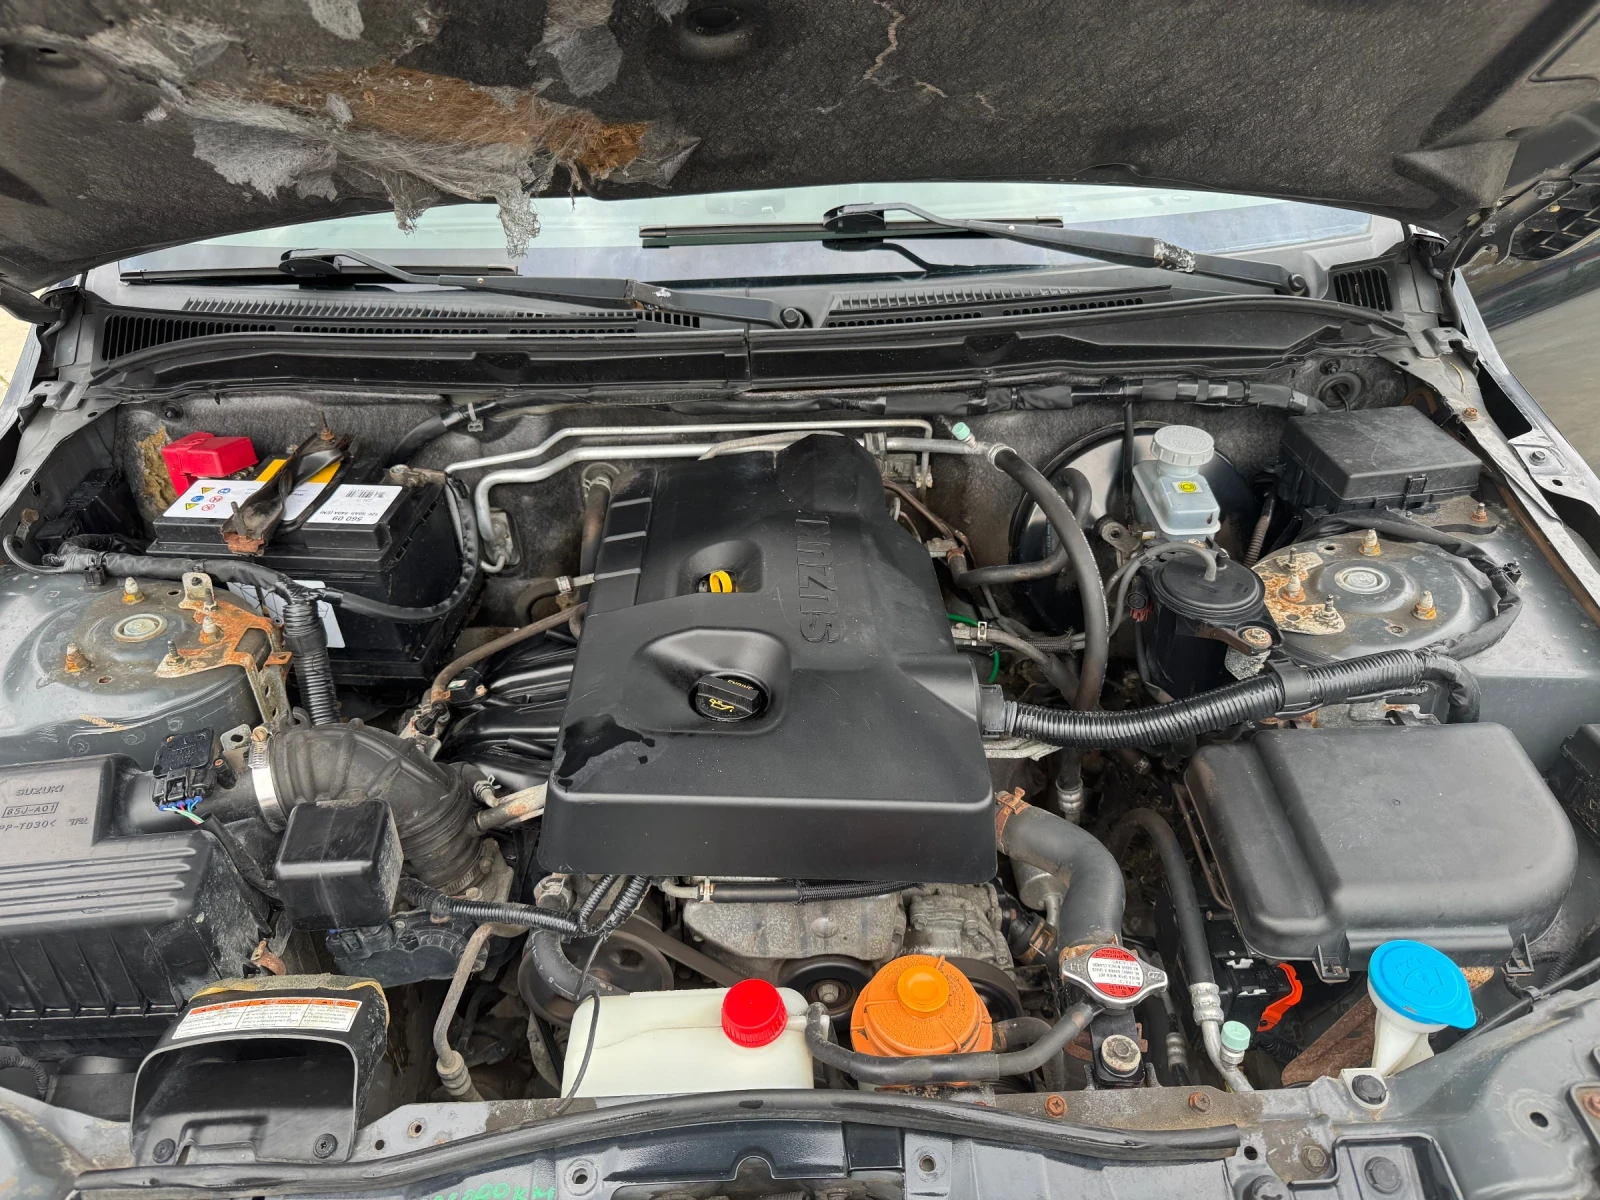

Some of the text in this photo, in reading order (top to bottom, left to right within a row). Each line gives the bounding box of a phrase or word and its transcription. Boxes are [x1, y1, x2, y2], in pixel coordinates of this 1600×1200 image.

[796, 518, 845, 643] SUZUKI
[15, 785, 64, 796] SUZUKI
[6, 804, 56, 816] 85J-A01
